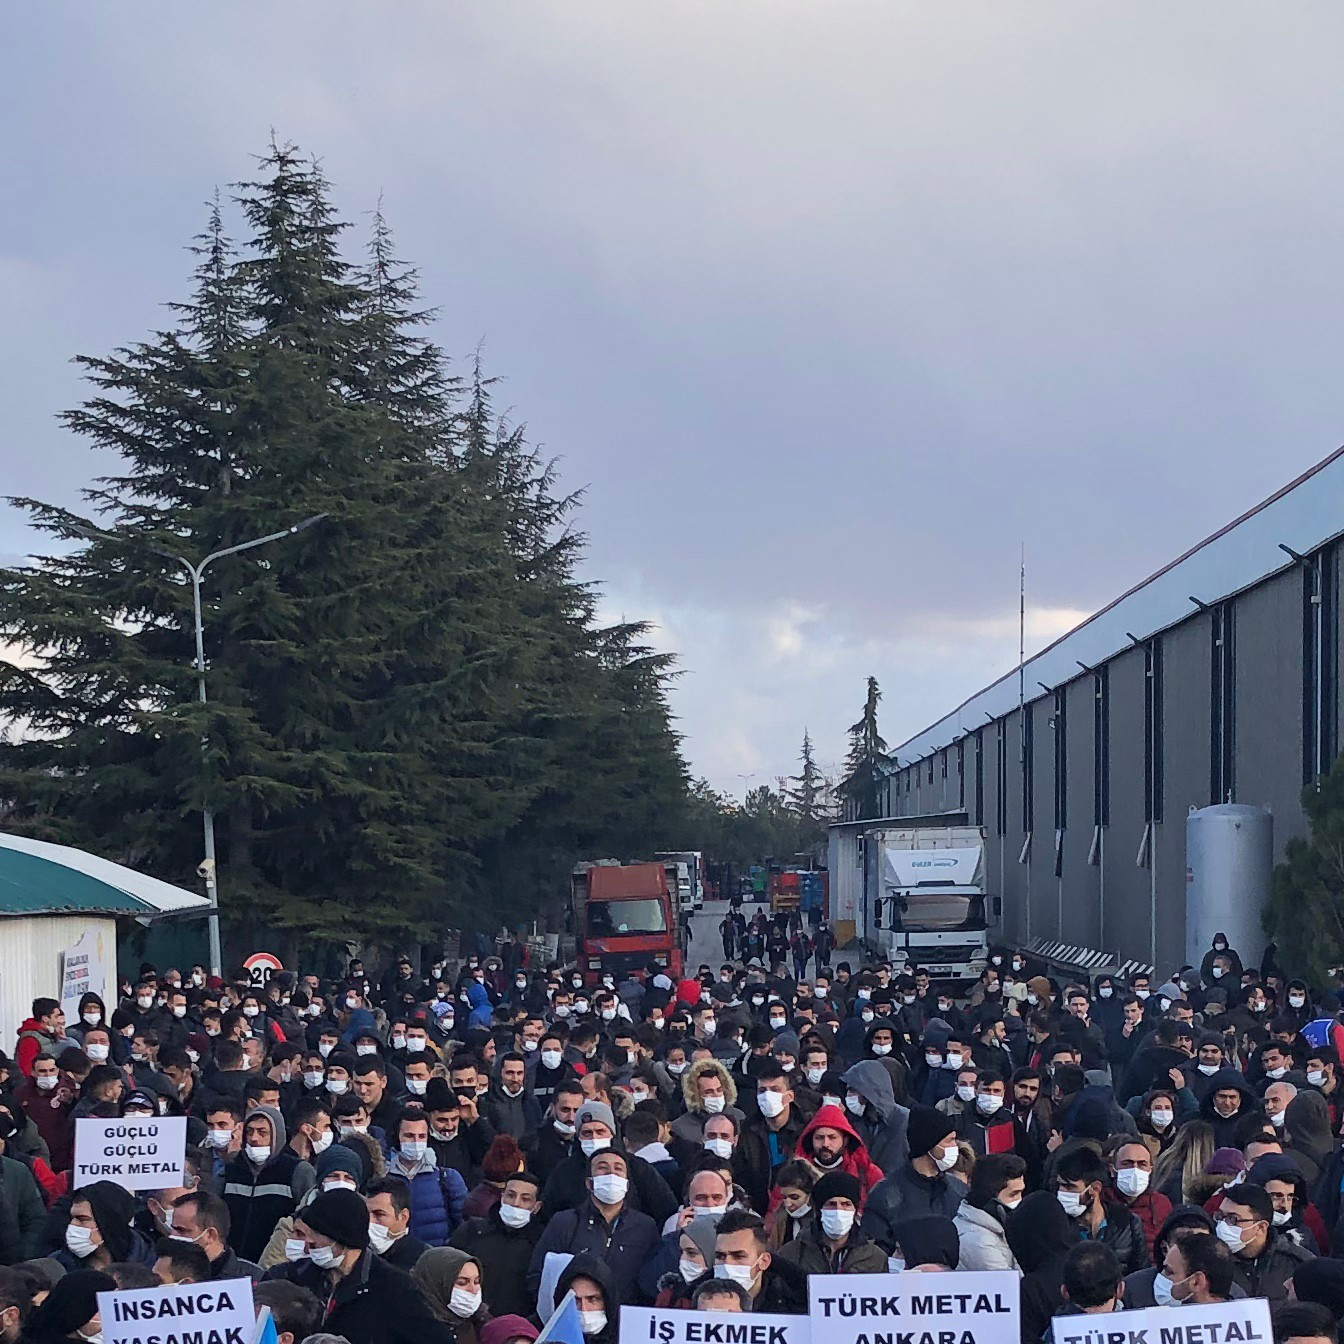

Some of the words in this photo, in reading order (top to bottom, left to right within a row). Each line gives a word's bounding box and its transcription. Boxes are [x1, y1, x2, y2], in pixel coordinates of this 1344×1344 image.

[104, 1125, 158, 1140] GÜÇLÜ
[103, 1143, 158, 1158] GÜÇLÜ
[78, 1163, 123, 1175] TÜRK
[128, 1162, 180, 1174] METAL
[113, 1291, 235, 1322] İNSANCA
[818, 1293, 901, 1317] TÜRK
[911, 1293, 1011, 1315] METAL
